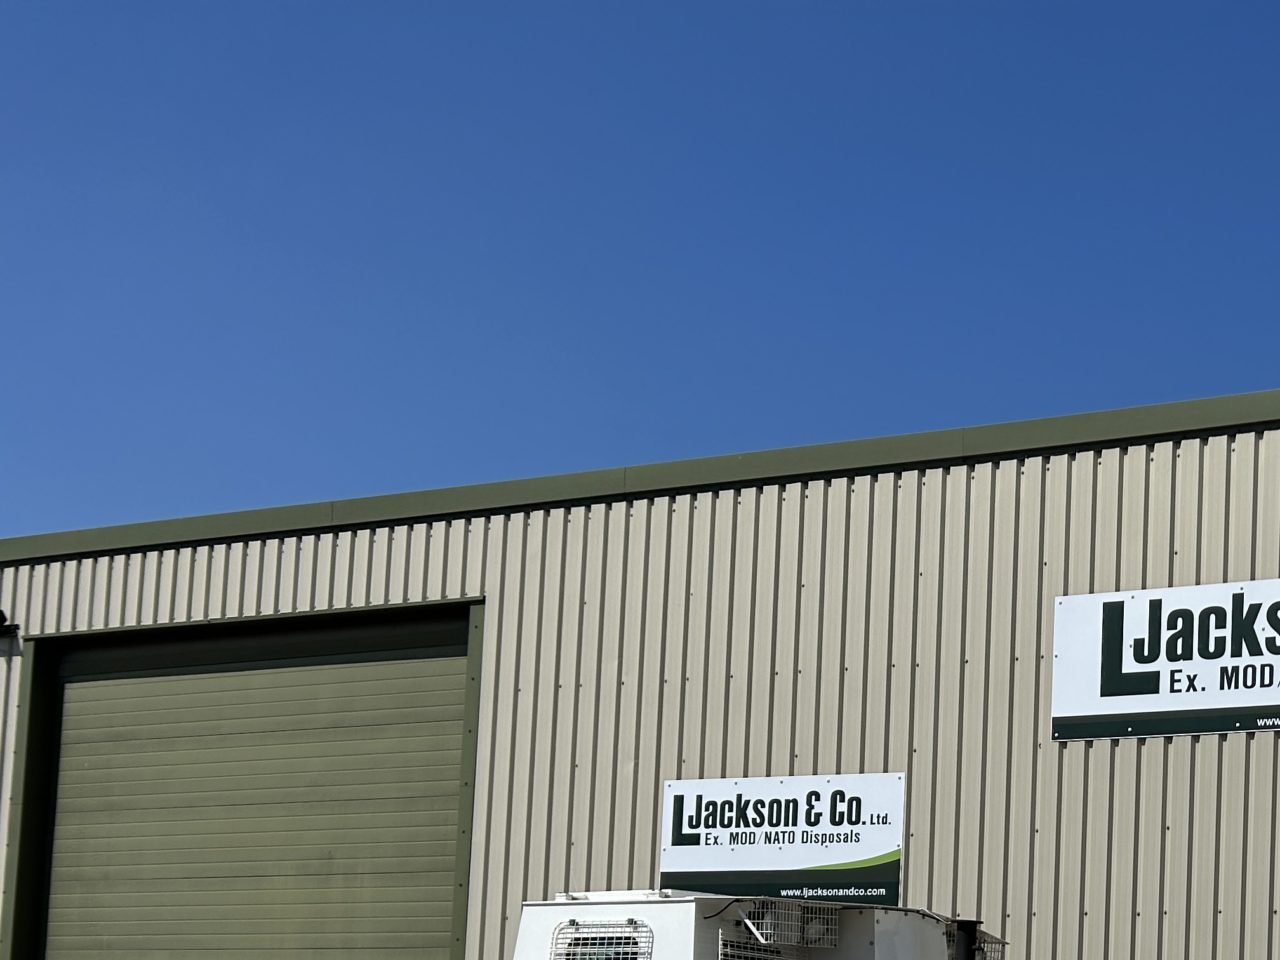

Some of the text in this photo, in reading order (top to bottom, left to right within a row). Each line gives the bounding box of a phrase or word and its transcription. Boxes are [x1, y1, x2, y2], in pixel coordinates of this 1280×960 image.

[1169, 668, 1207, 695] Ex.
[804, 790, 823, 827] &
[829, 789, 867, 826] Co.
[869, 813, 892, 826] Ltd.
[704, 832, 724, 847] Ex.
[801, 829, 861, 847] Disposals
[780, 887, 886, 898] www.ljacksonandco.com
